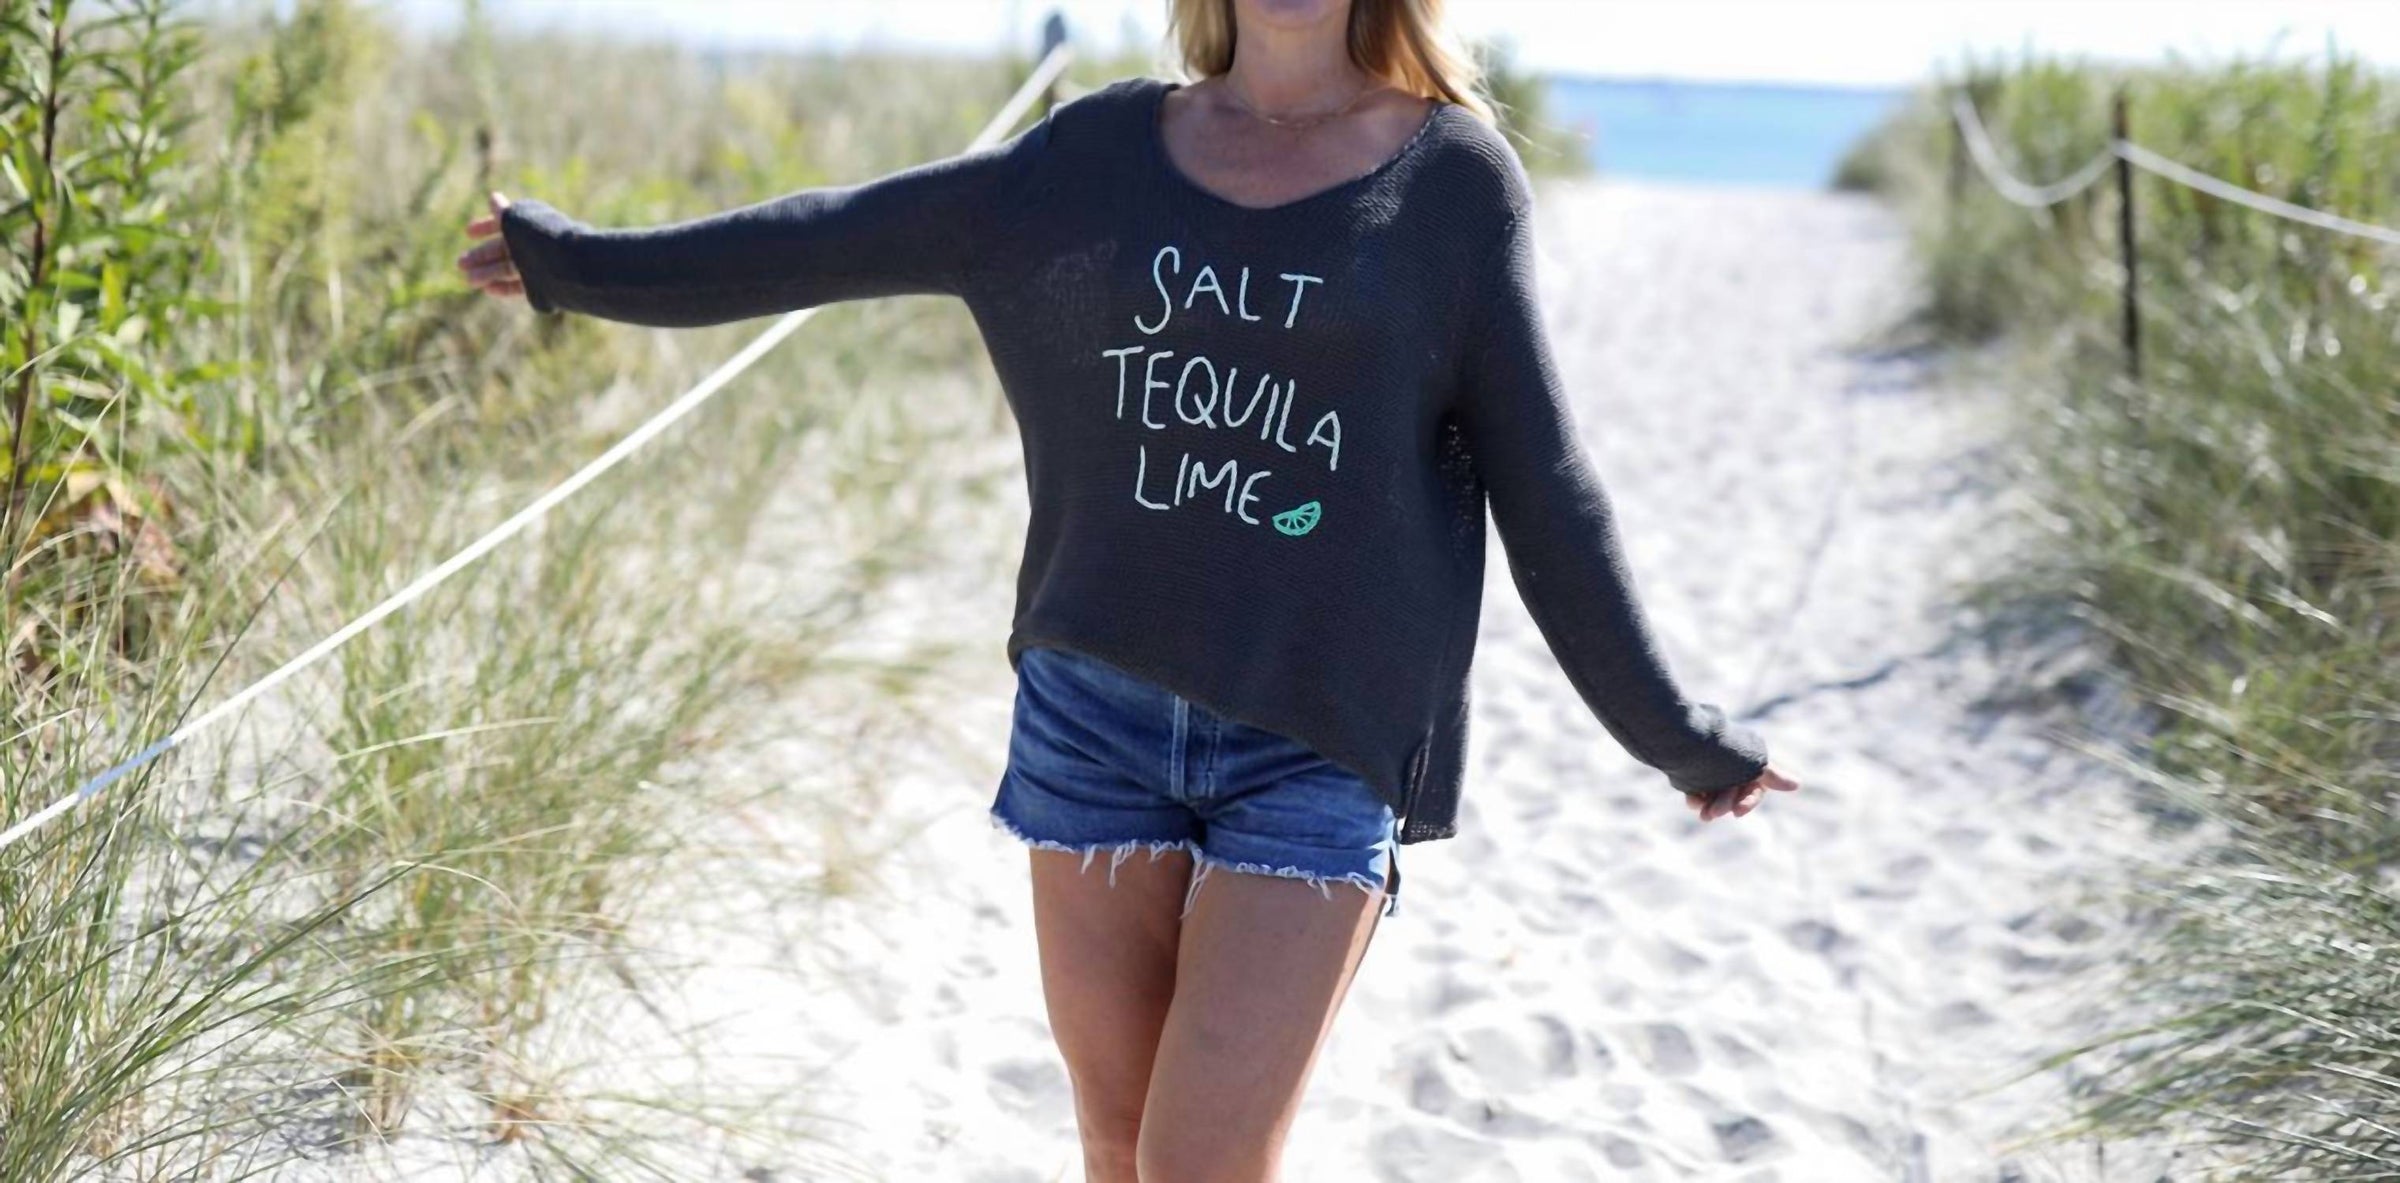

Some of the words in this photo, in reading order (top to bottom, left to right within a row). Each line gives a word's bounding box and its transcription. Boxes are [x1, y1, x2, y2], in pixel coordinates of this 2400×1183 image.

[1134, 246, 1324, 335] SALT
[1102, 345, 1342, 472] TEQUILA
[1134, 445, 1273, 526] LIME
